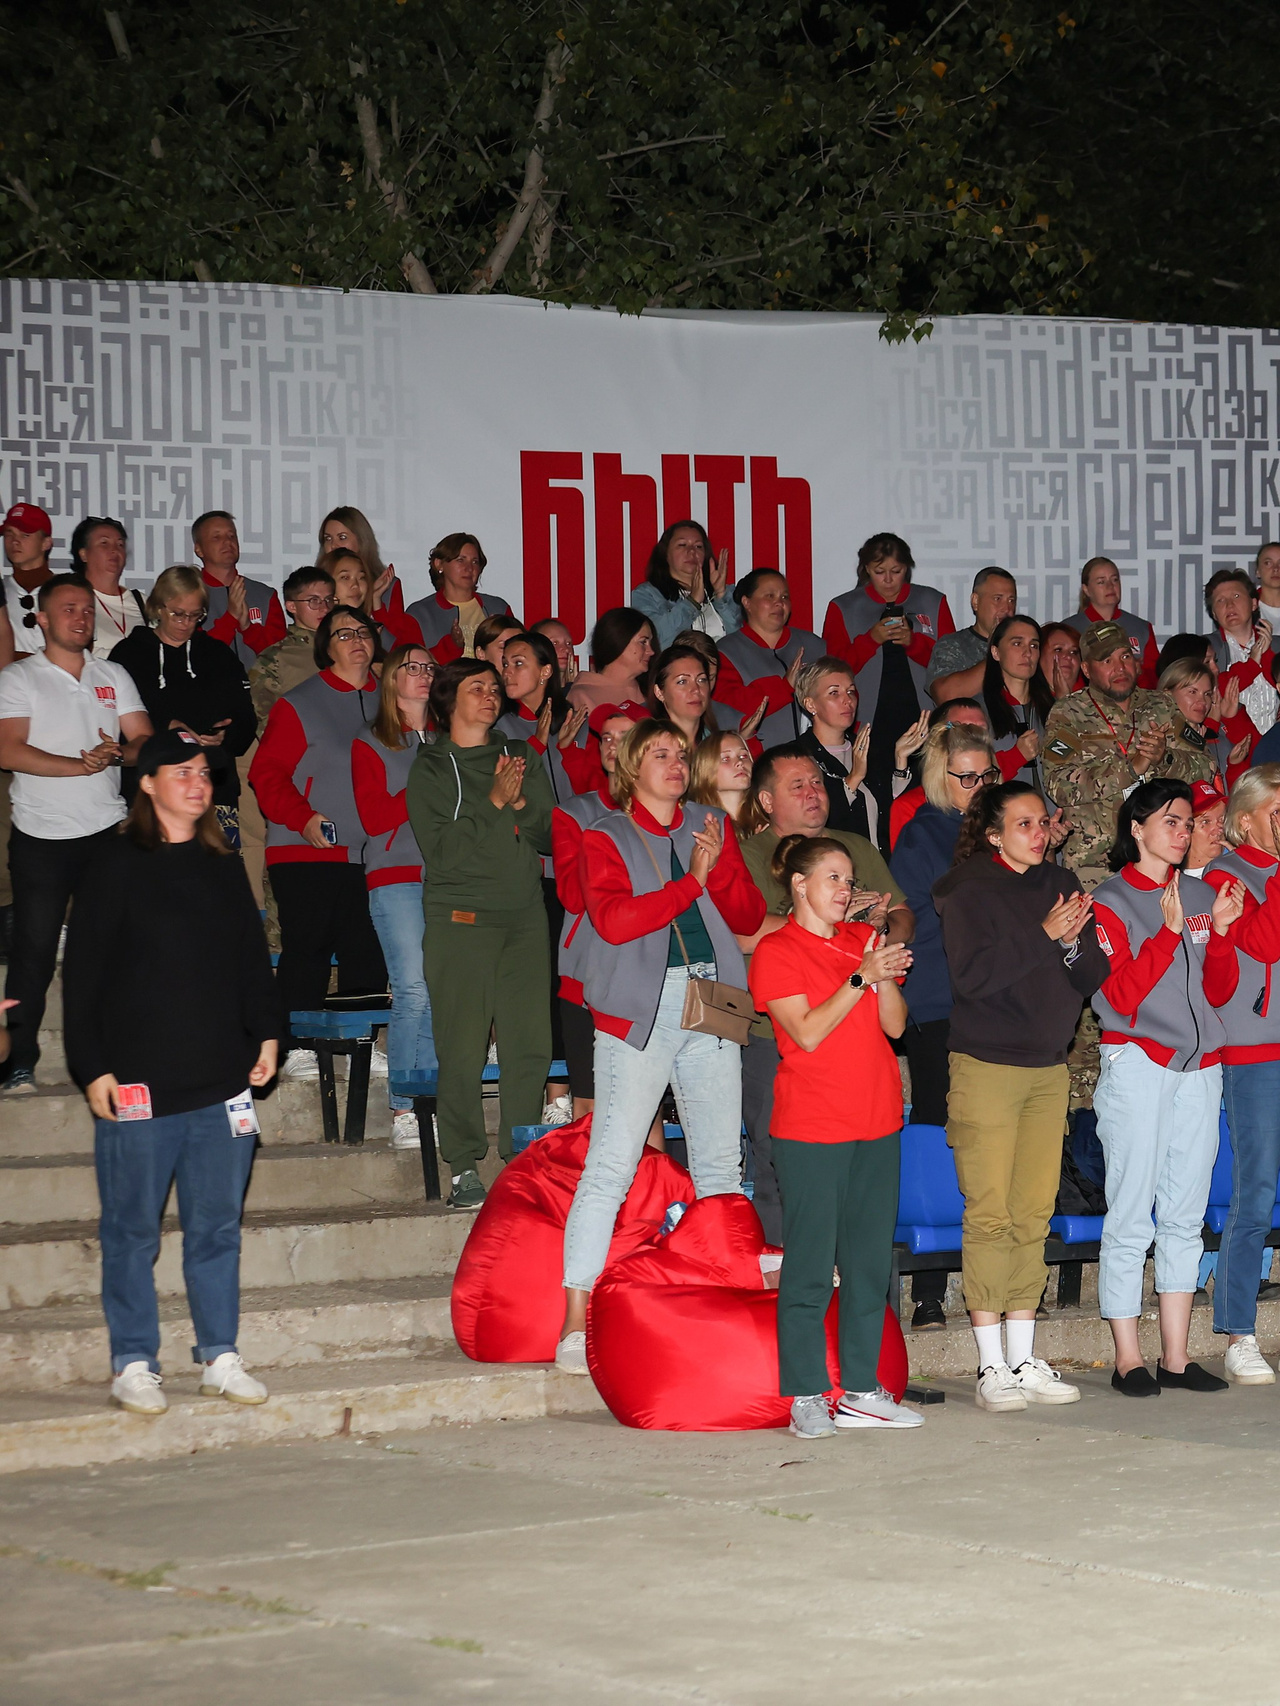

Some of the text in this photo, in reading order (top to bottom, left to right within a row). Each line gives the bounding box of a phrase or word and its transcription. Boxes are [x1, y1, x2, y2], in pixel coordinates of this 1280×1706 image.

[0, 444, 194, 520] АЗАТЬСЯ
[520, 450, 813, 646] БЫТЬ
[1185, 914, 1212, 932] БЫТЬ
